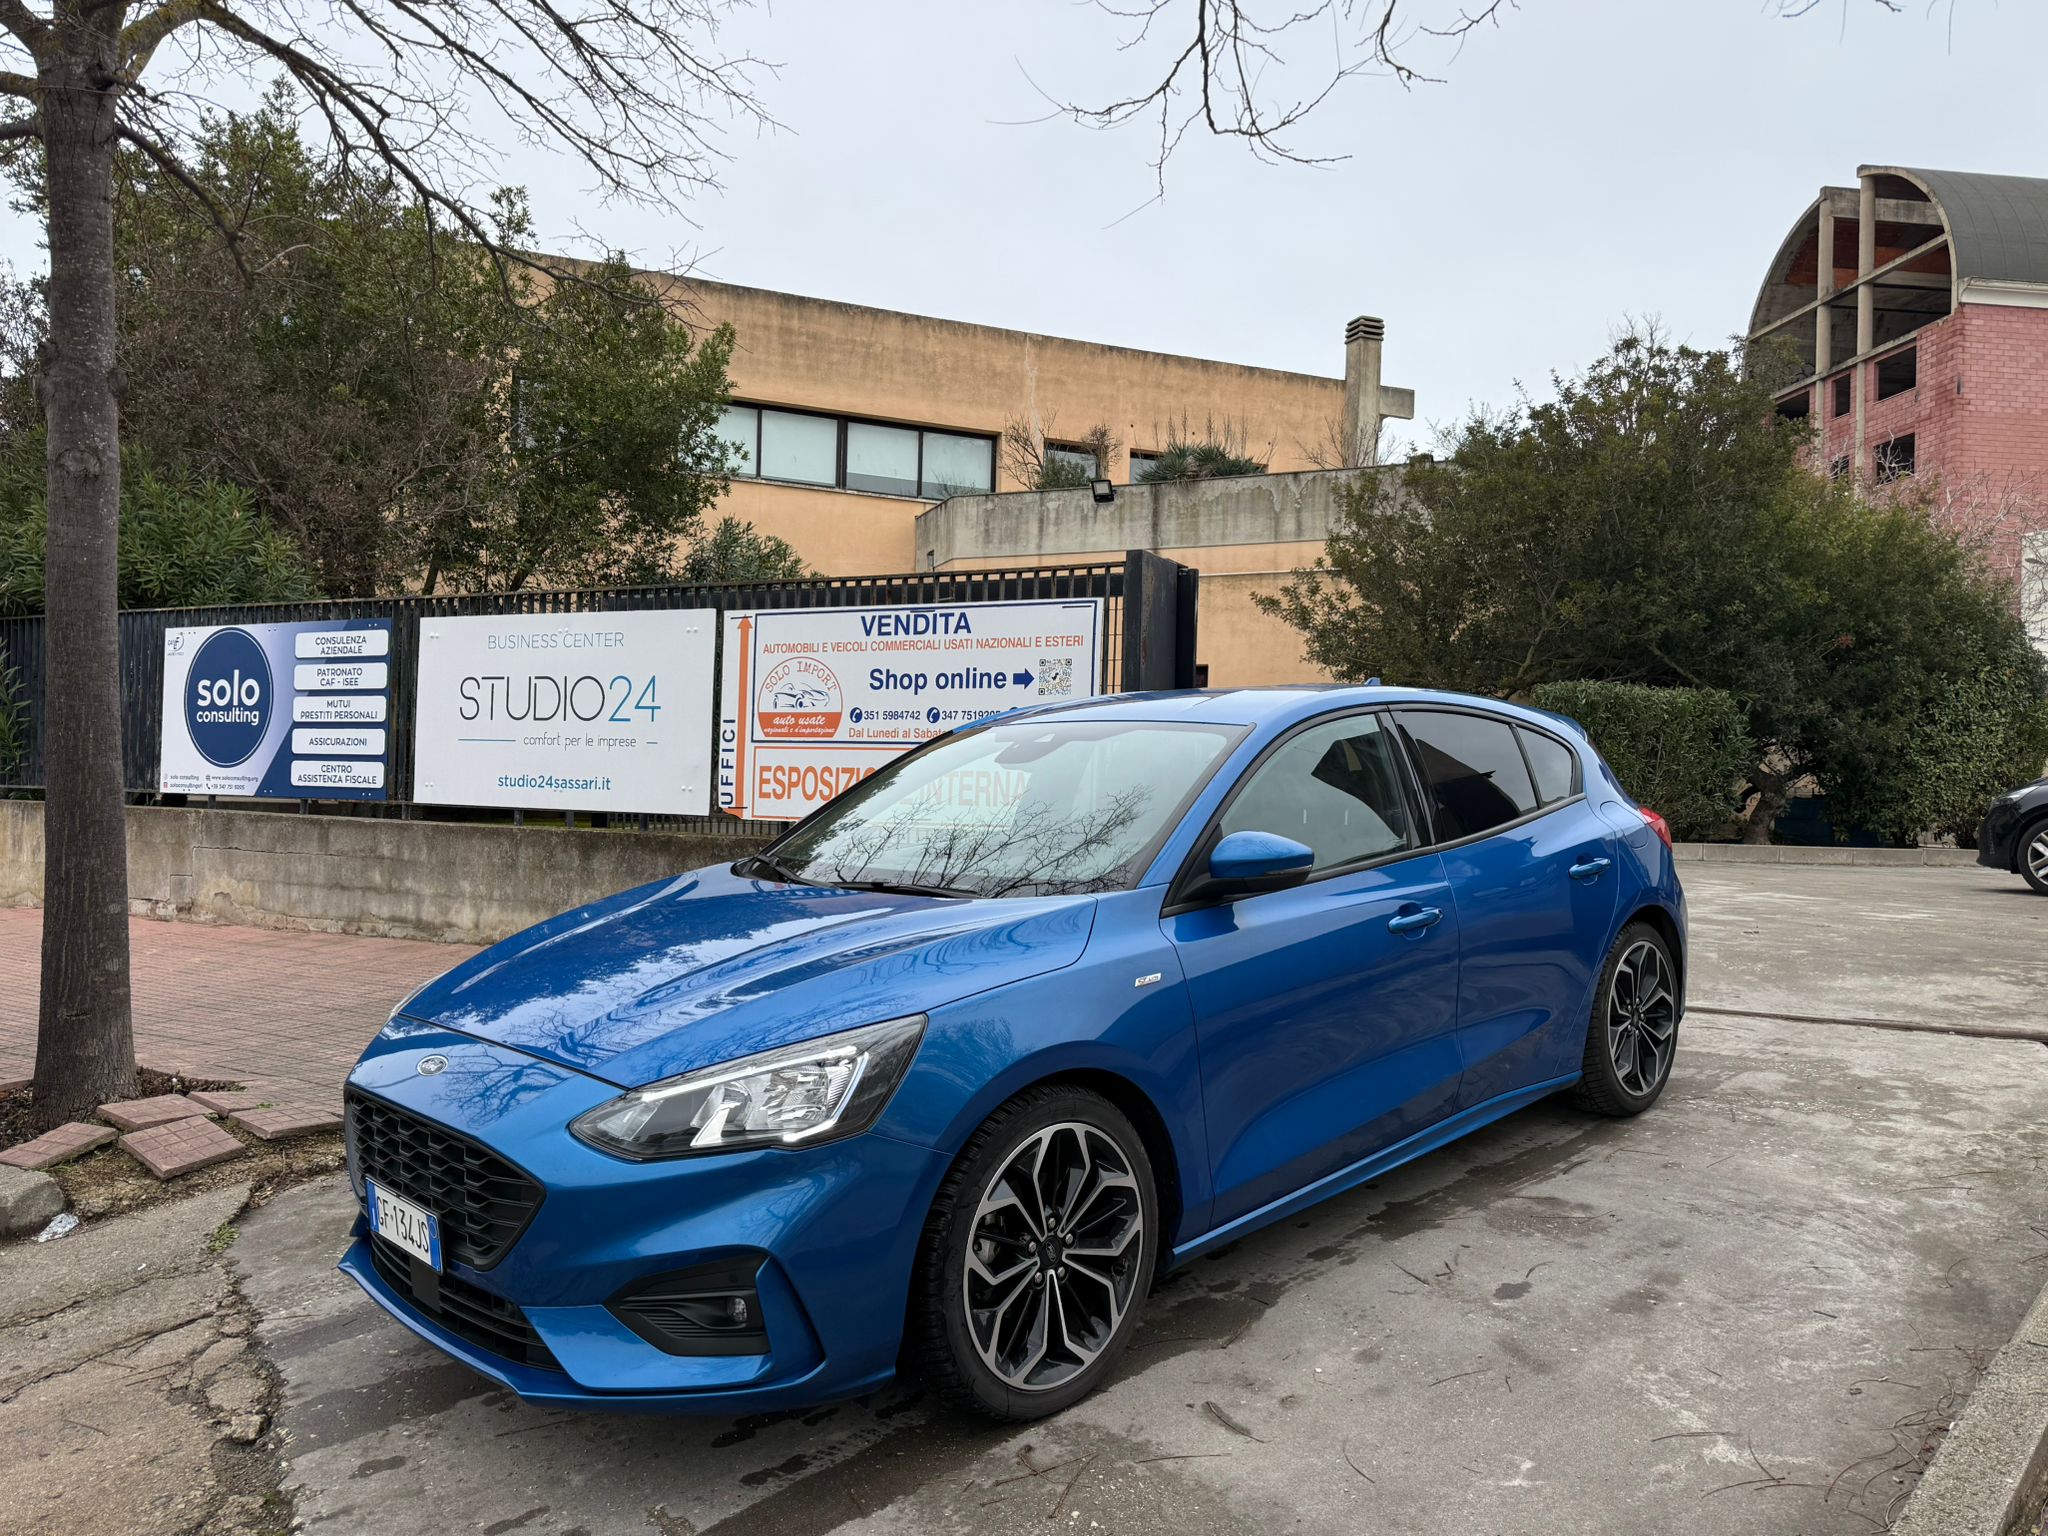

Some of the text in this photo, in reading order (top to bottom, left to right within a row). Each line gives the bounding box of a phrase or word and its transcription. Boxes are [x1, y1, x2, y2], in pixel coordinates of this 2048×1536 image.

[860, 612, 972, 637] VENDITA
[315, 636, 367, 646] CONSULENZA
[487, 632, 625, 650] BUSINESS CENTER
[763, 635, 1084, 654] AUTOMOBILI E VEICOLI COMMERCIALI USATI NAZIONALI E ESTERI
[320, 646, 363, 655] AZIENDALE
[316, 667, 363, 677] PATRONATO
[765, 661, 837, 693] SOLO IMPORT
[319, 678, 336, 687] CAF
[342, 677, 359, 686] ISEE
[869, 667, 1007, 695] Shop online
[197, 669, 260, 707] solo
[326, 700, 351, 708] MUTUI
[459, 675, 662, 723] STUDIO24
[196, 707, 259, 726] consulting
[300, 710, 378, 720] PRESTITI PERSONALI
[772, 714, 827, 725] auto usate
[864, 710, 921, 720] 351 5984742
[941, 710, 1001, 720] 347 75192
[848, 727, 864, 738] Dal
[902, 728, 911, 738] al
[913, 728, 946, 739] Sabat
[309, 737, 368, 746] ASSICURAZIONI
[523, 732, 637, 752] comfort per le imprese
[720, 719, 736, 806] UFFICI
[320, 764, 353, 774] CENTRO
[297, 774, 377, 785] ASSISTENZA FISCALE
[498, 773, 612, 791] studio24sassari.it
[758, 765, 878, 801] ESPOSIZ
